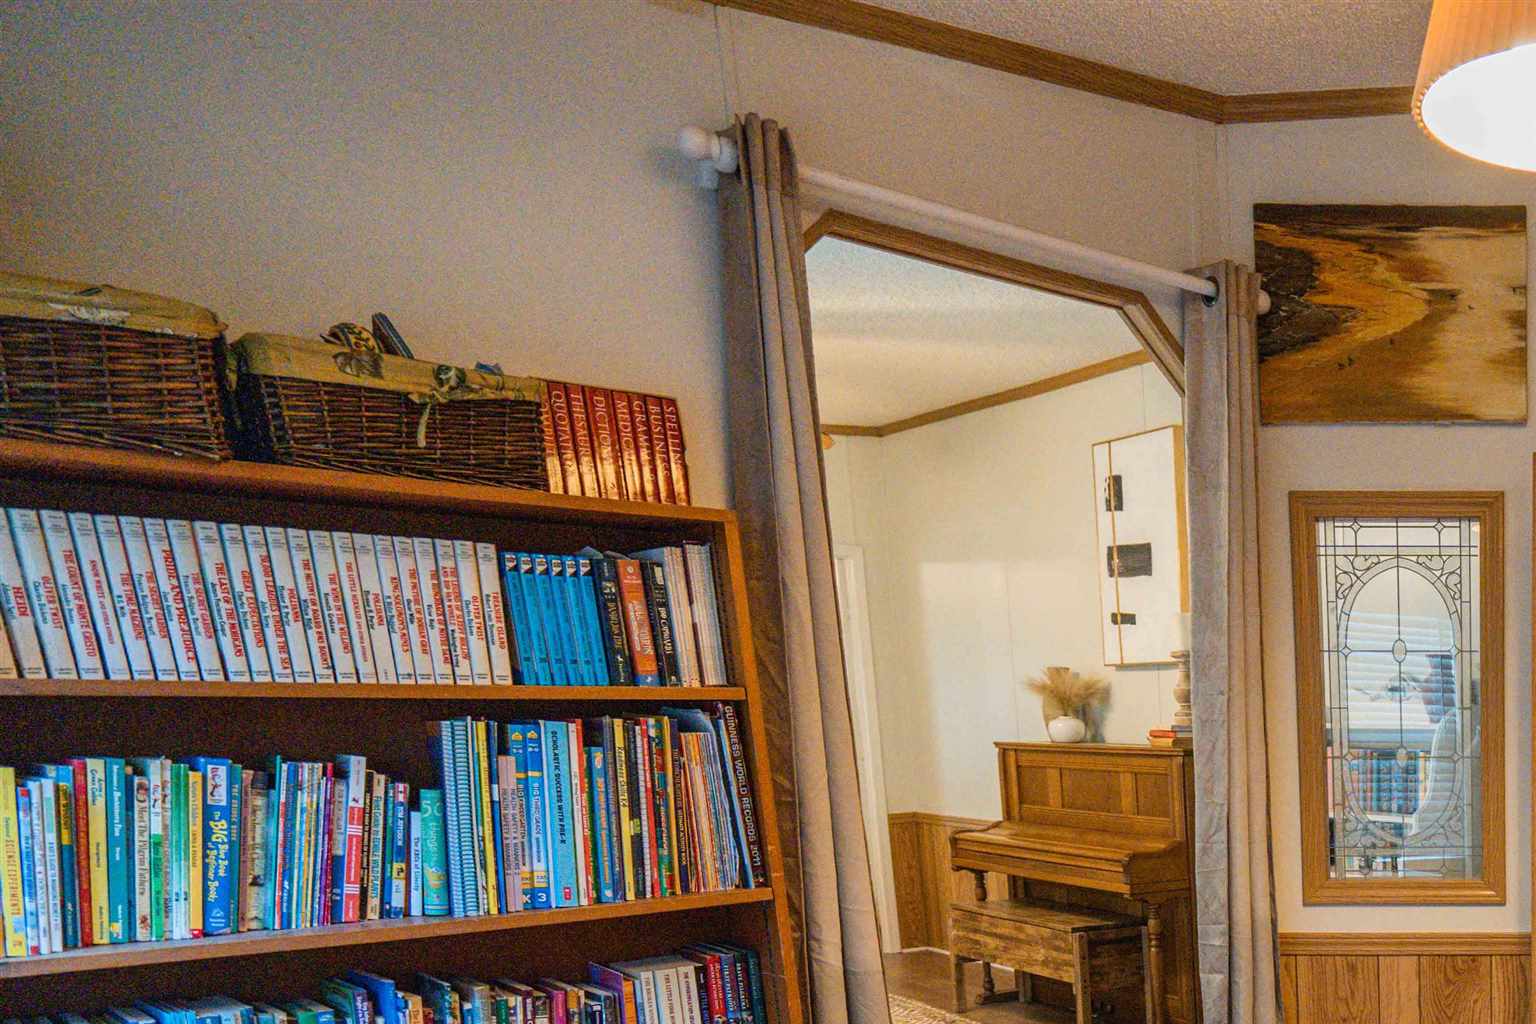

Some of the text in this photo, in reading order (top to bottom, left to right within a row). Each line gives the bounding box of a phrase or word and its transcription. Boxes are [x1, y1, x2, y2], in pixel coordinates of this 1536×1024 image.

[62, 550, 75, 565] THE
[215, 562, 225, 576] THE
[218, 578, 229, 595] LAST
[12, 586, 29, 617] HEIDI
[41, 576, 64, 630] OLIVER TWIST
[162, 550, 195, 664] PRIDE AND PREJUDICE
[221, 595, 231, 604] OF
[225, 608, 235, 621] THE
[276, 640, 287, 654] THE
[280, 657, 290, 670] SEA
[551, 730, 567, 844] SCHOLASTIC SUCCESS WITH PRE-K
[723, 705, 761, 867] GUINNESS WORLD RECORDS 2011
[139, 805, 148, 823] Meet
[139, 825, 148, 838] The
[209, 819, 228, 843] BIG
[537, 893, 547, 903] 3
